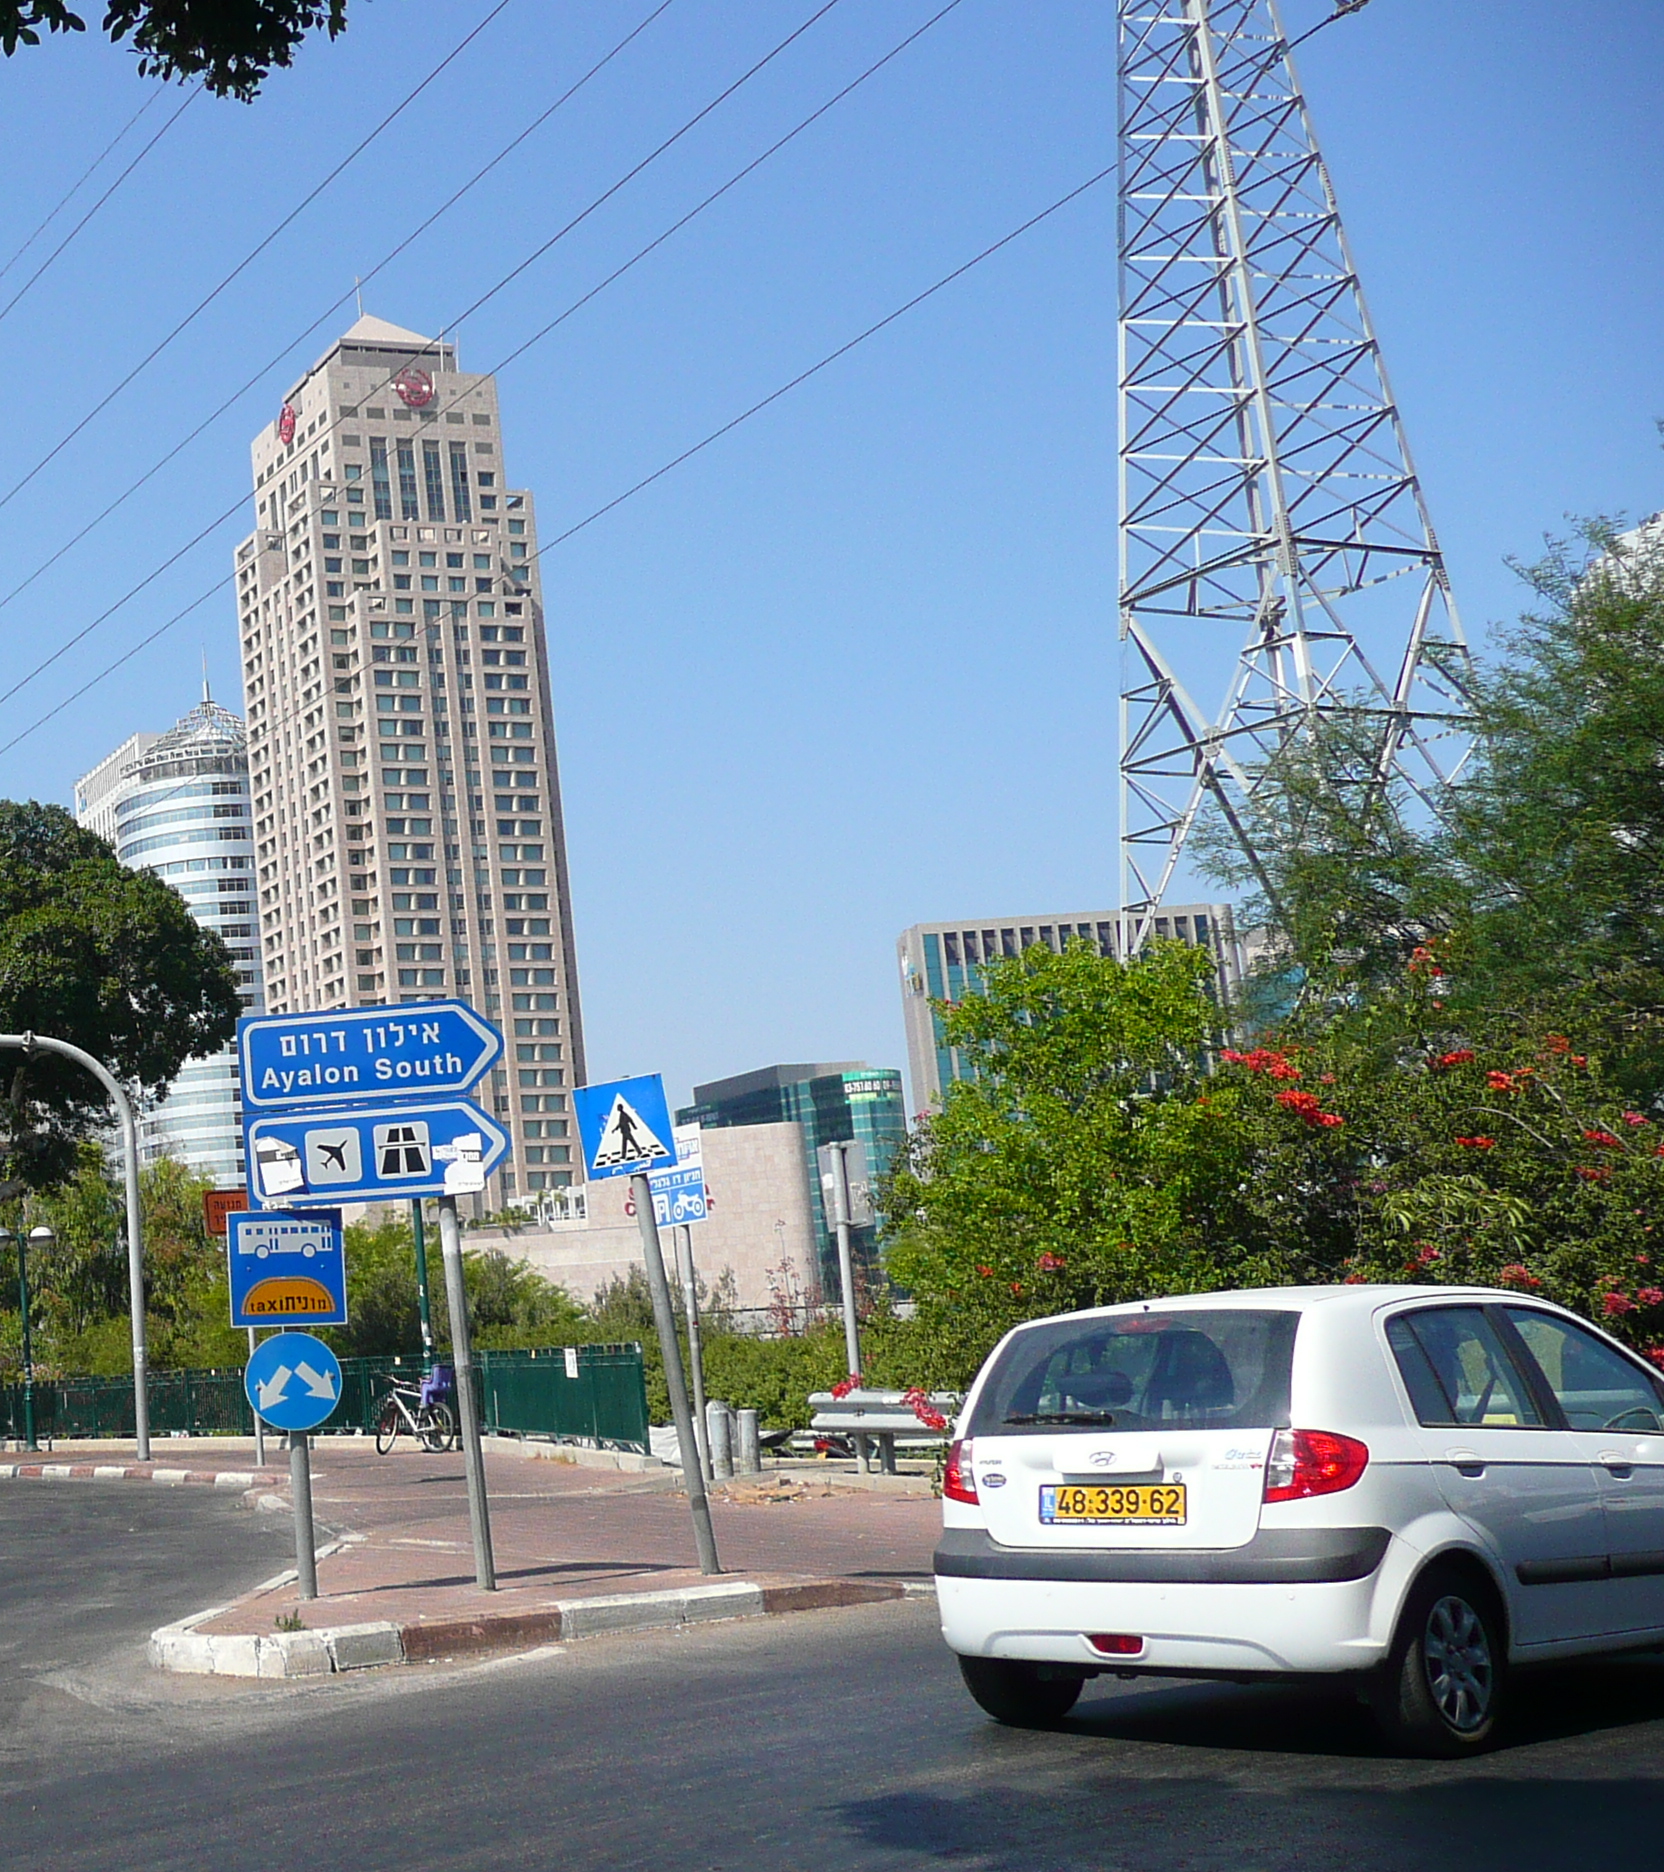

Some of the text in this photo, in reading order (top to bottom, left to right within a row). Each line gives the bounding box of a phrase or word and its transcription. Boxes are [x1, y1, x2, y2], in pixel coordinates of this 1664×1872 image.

[280, 1022, 440, 1056] אילון דרום
[262, 1052, 462, 1093] Ayalon South
[250, 1295, 283, 1312] taxi
[285, 1295, 327, 1311] מונית
